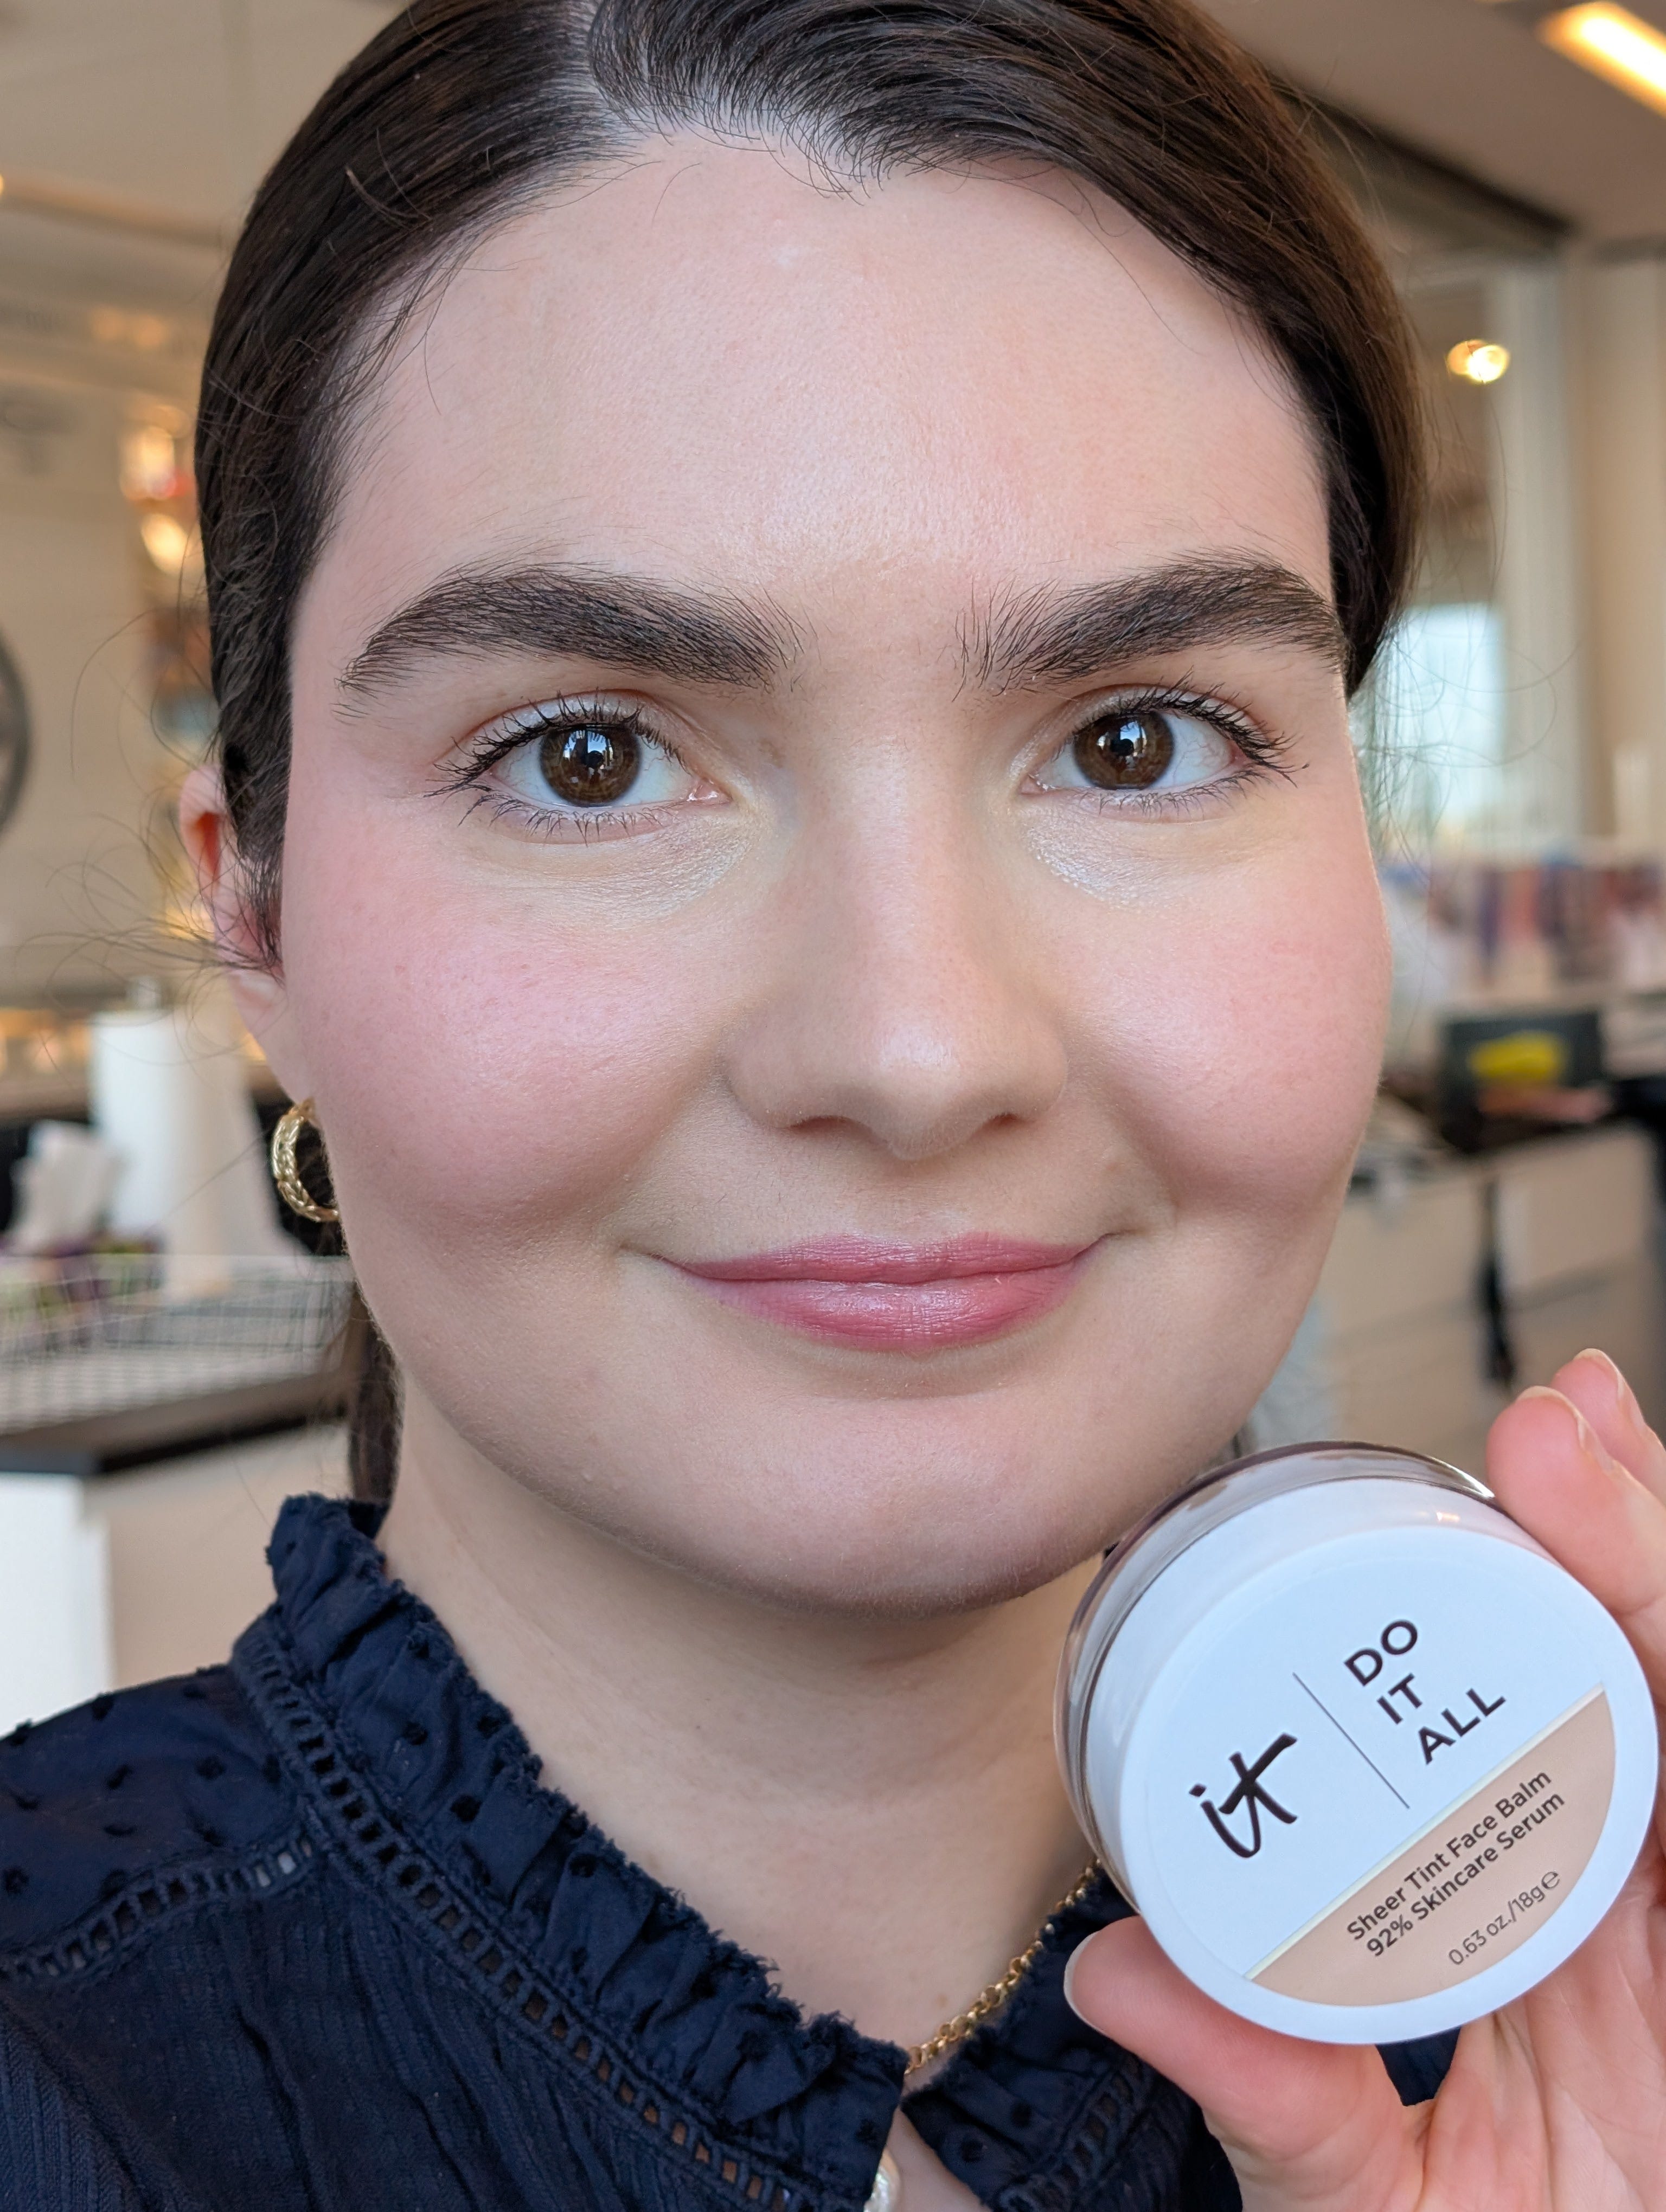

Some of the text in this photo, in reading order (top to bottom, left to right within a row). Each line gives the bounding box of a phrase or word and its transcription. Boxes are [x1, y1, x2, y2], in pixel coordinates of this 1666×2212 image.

[1344, 1619, 1418, 1687] DO
[1376, 1673, 1423, 1725] IT
[1418, 1688, 1507, 1765] ALL
[1189, 1733, 1298, 1859] it
[1347, 1771, 1552, 1940] Sheer Tint Face Balm
[1367, 1792, 1565, 1957] 92% Skincare Serum
[1448, 1929, 1487, 1965] 0.63
